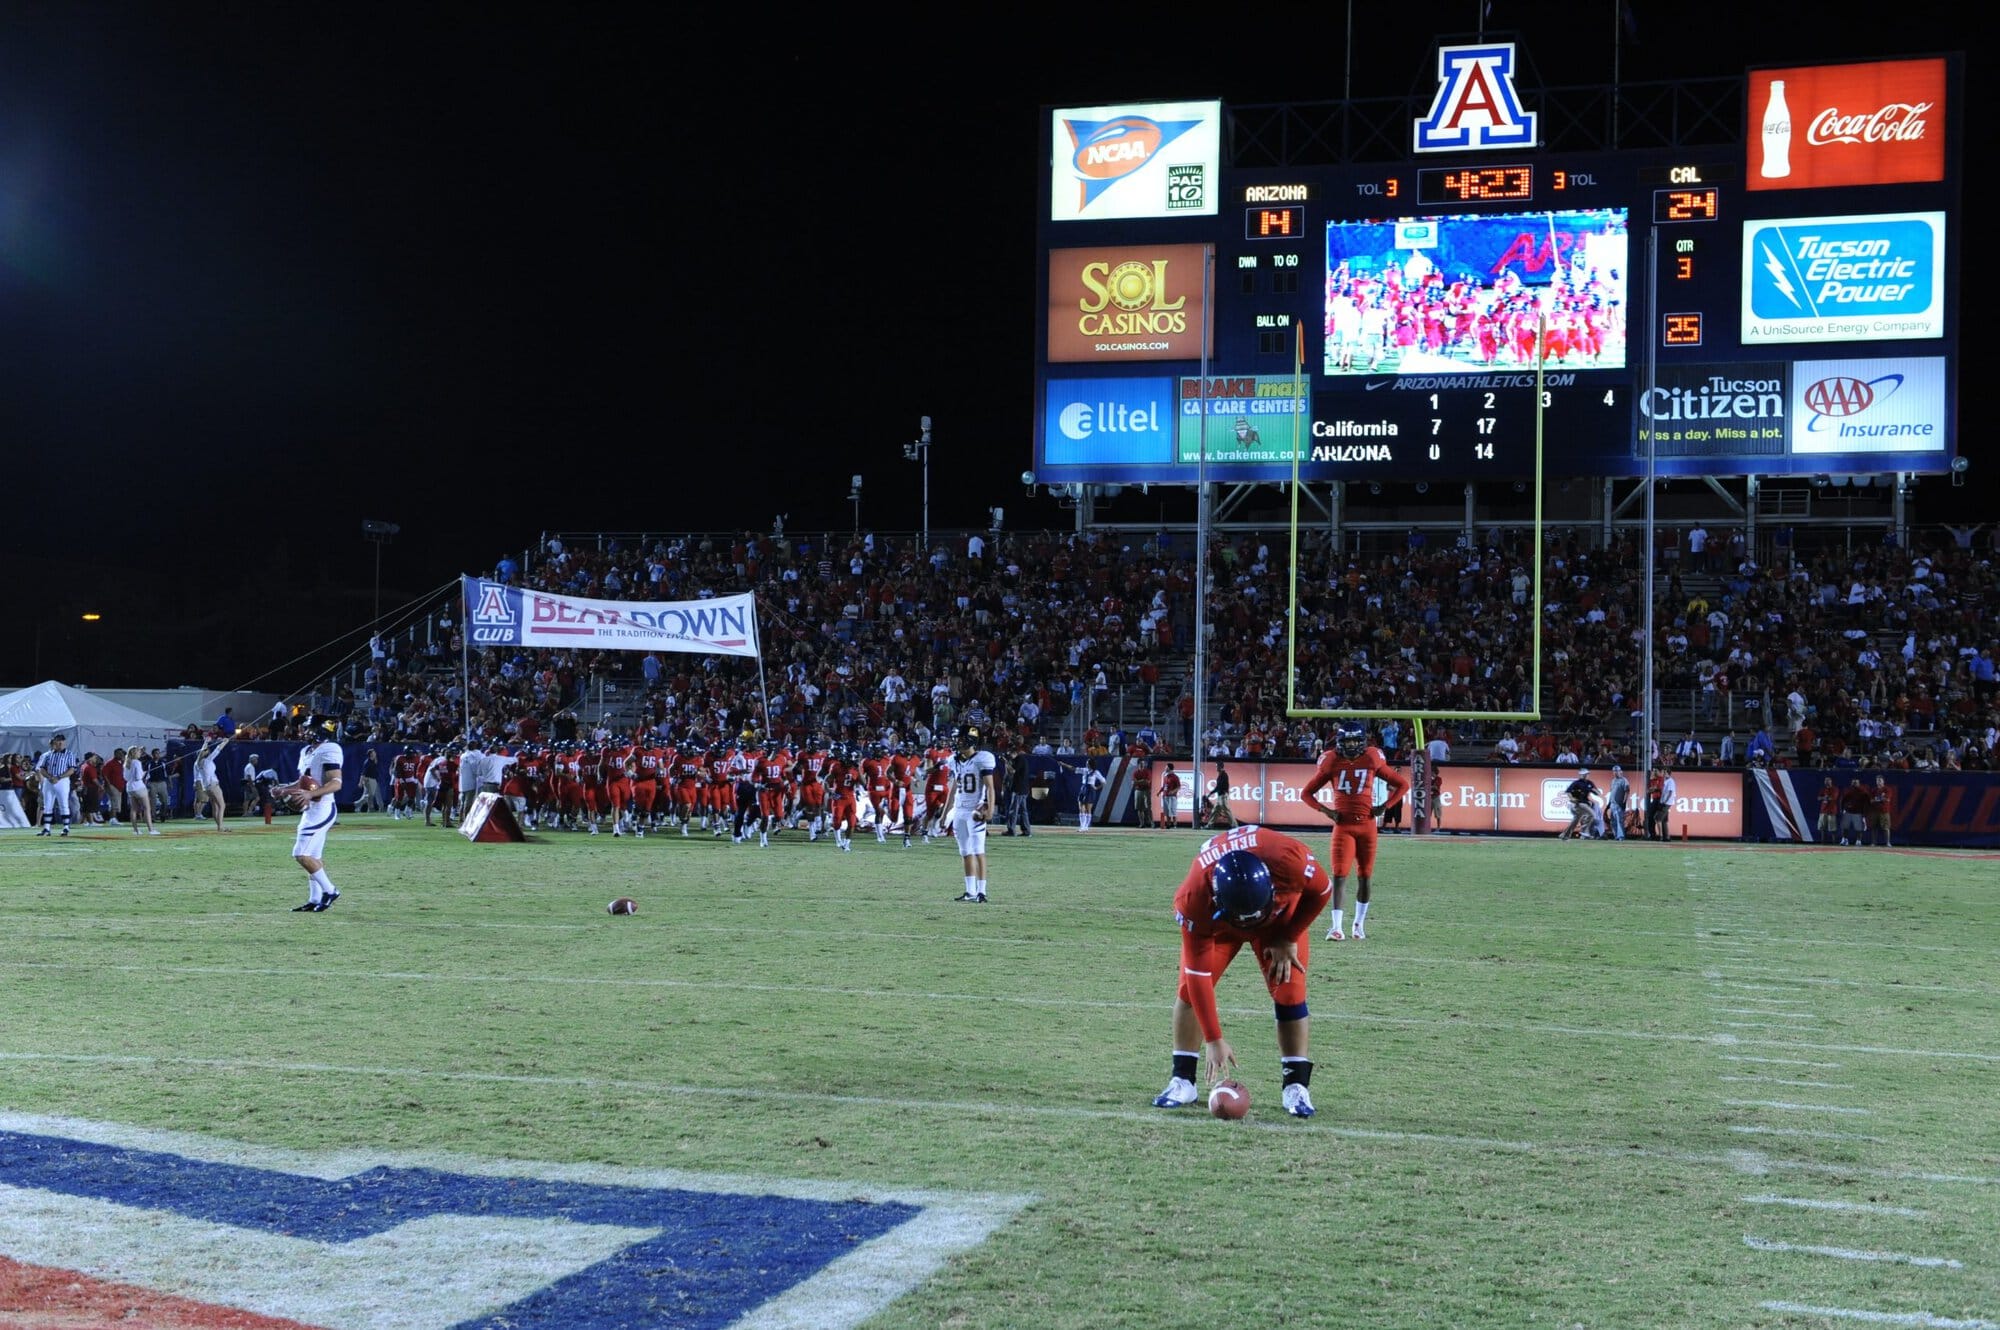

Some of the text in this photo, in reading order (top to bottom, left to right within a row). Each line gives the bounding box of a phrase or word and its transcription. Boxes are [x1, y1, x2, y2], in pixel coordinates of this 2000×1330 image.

[1413, 42, 1538, 153] A
[1807, 102, 1934, 145] Coca-Cola
[1087, 141, 1146, 166] NCAA
[1169, 175, 1202, 186] PAC
[1446, 168, 1530, 200] 4:23
[1553, 171, 1596, 190] 3 TOL
[1670, 166, 1702, 184] CAL
[1169, 186, 1202, 201] 10
[1245, 185, 1307, 202] ARIZONA
[1357, 179, 1398, 197] TOL 3
[1669, 192, 1716, 219] 24
[1261, 209, 1290, 235] 14
[1676, 239, 1694, 252] QTR
[1797, 235, 1891, 260] Tucson
[1238, 254, 1298, 268] DWN TO GO
[1677, 257, 1692, 279] 3
[1806, 256, 1917, 281] Electric
[1080, 260, 1186, 313] SOL
[1816, 281, 1916, 304] Power
[1079, 312, 1187, 336] CASINOS
[1256, 314, 1289, 327] BALL ON
[1666, 316, 1699, 342] 25
[1750, 320, 1931, 336] A UniSource Energy Company
[1095, 342, 1169, 352] SOLCASINOS.COM
[1392, 374, 1575, 390] ARIZONAATHLETICS.COM
[1708, 376, 1781, 393] Tucson
[1213, 400, 1247, 414] CARE
[1251, 399, 1306, 414] CENTERS
[1430, 390, 1614, 410] 1 2 3 4
[1640, 386, 1785, 420] Citizen
[1807, 378, 1872, 416] AAA
[1061, 401, 1158, 439] alltel
[1312, 418, 1496, 437] California 7 17
[1639, 427, 1783, 441] Mss a day. Miss a lot.
[1839, 422, 1934, 438] Insurance
[1311, 443, 1494, 462] ARIZONA 0 14
[473, 582, 515, 625] A
[630, 606, 745, 638] DOWN
[473, 628, 515, 642] CLUB
[598, 629, 613, 637] THE
[616, 629, 662, 639] TRADITION
[604, 684, 616, 693] 26
[1744, 699, 1760, 709] 29
[642, 756, 656, 769] 66
[1207, 779, 1262, 802] Sate
[1337, 768, 1367, 795] 47
[1414, 754, 1426, 818] ARIZONA
[1458, 785, 1526, 808] Farm
[1675, 796, 1730, 813] arm
